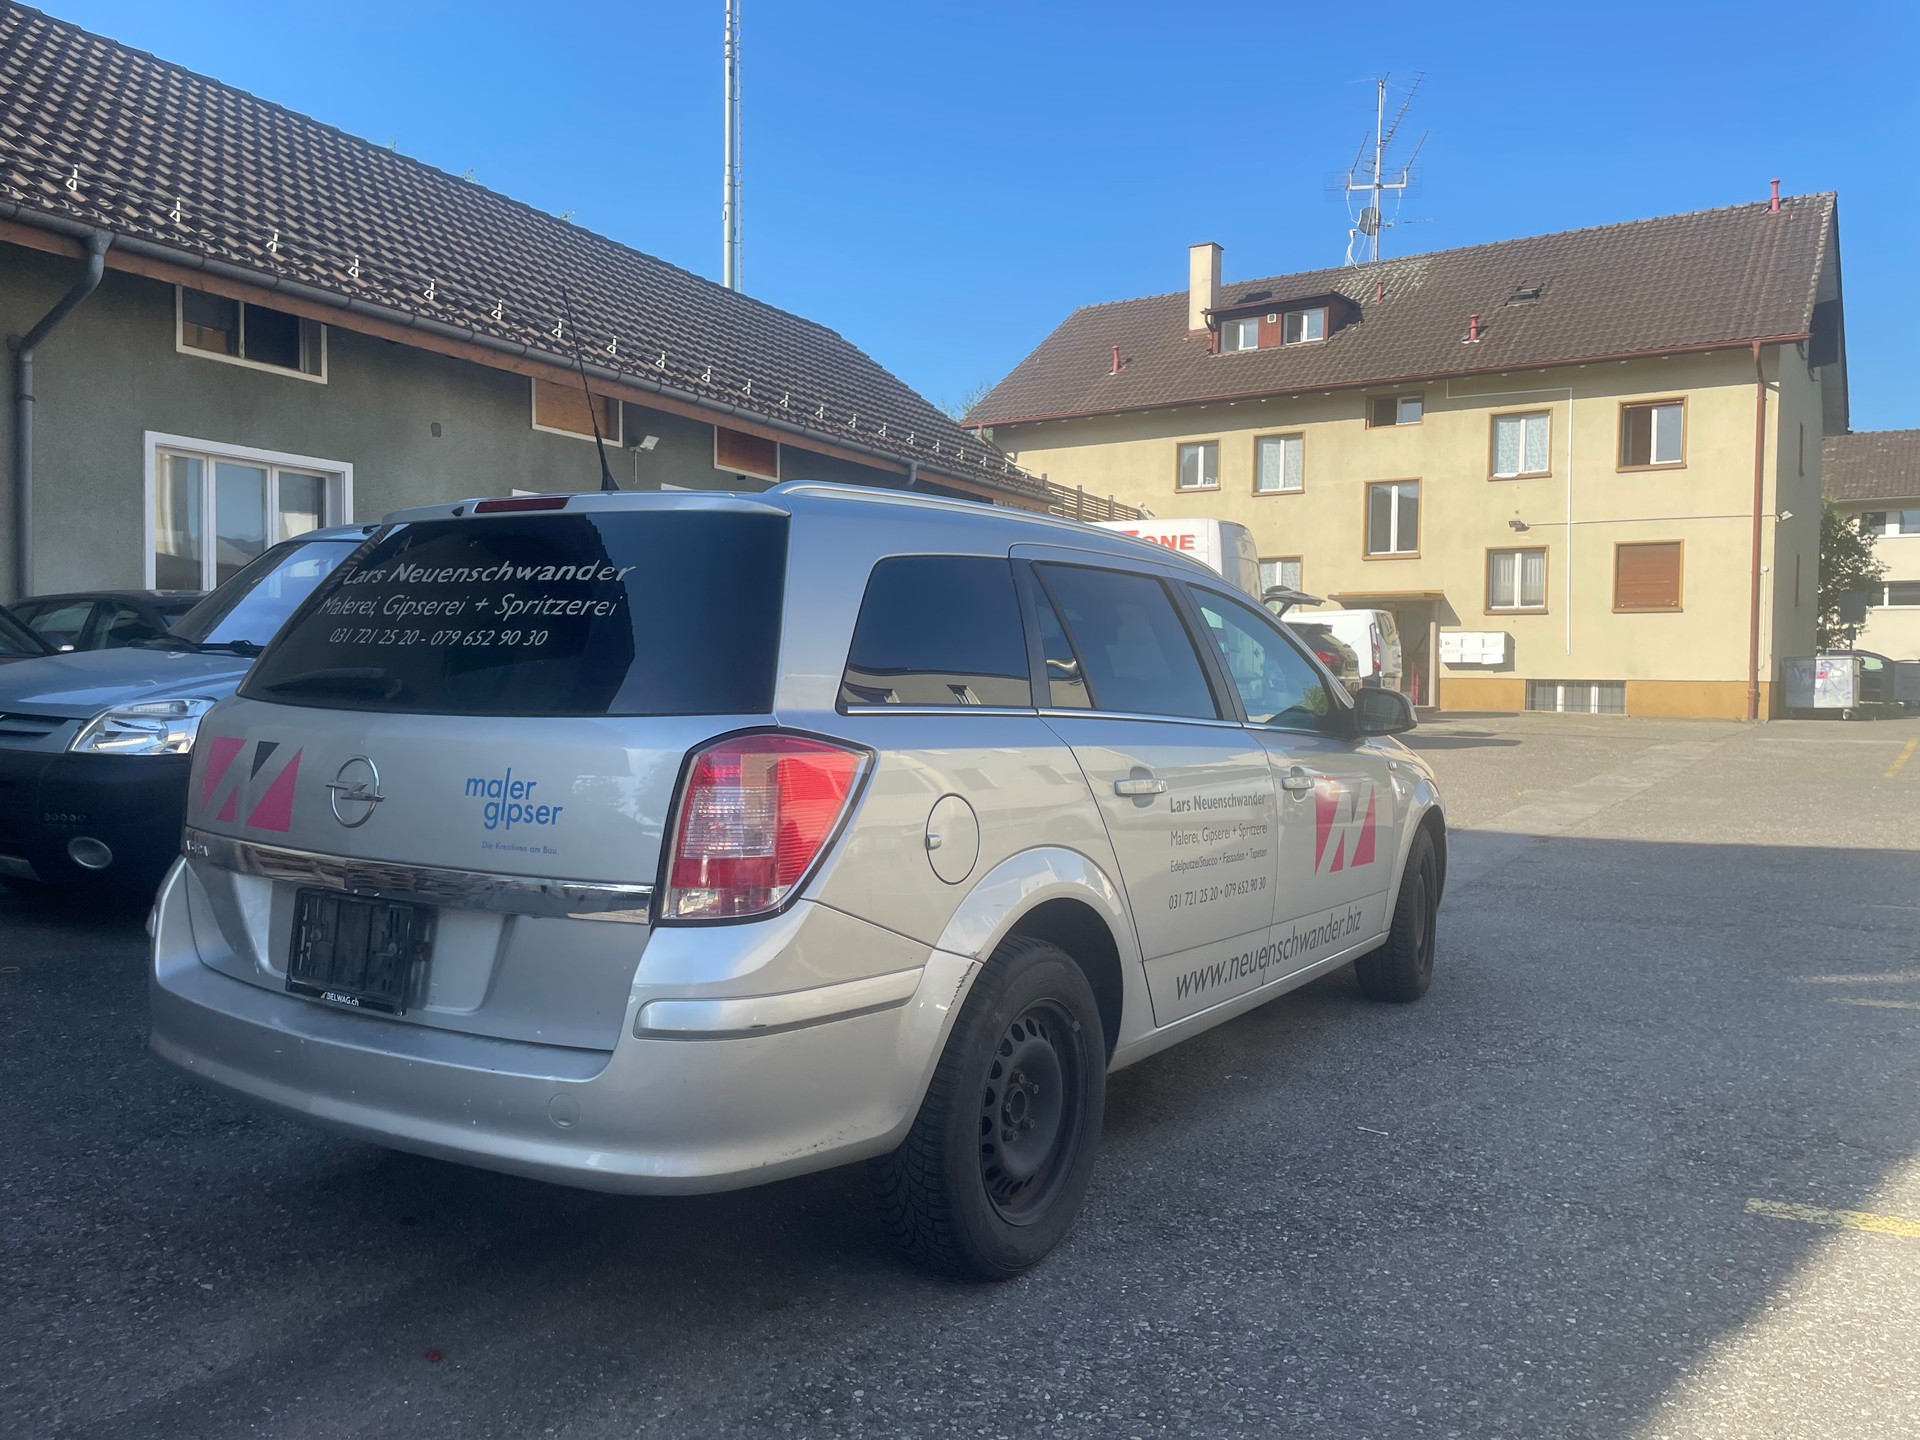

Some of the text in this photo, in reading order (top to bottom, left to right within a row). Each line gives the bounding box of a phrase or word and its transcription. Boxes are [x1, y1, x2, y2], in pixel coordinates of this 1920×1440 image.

[343, 560, 637, 585] Lars Neuenschwander
[318, 596, 381, 618] Malerei,
[383, 594, 470, 622] Gipserei
[495, 593, 623, 622] Spritzerei
[329, 628, 351, 643] 031
[353, 628, 378, 644] 721
[378, 629, 399, 645] 25
[399, 630, 420, 645] 20
[430, 630, 462, 646] 079
[462, 630, 495, 646] 652
[498, 630, 522, 646] 90
[523, 630, 549, 646] 30
[465, 767, 537, 800] maler
[1170, 792, 1266, 813] Lars Neuenschwander
[1202, 825, 1231, 846] Gipserei
[1239, 822, 1268, 840] Spritzerei
[482, 840, 493, 850] Die
[495, 842, 527, 852] Kreativen
[530, 846, 541, 854] am
[1168, 894, 1182, 910] 031
[1184, 891, 1197, 906] 721
[1199, 888, 1208, 904] 25
[1209, 886, 1219, 901] 20
[1224, 882, 1237, 898] 079
[1237, 880, 1249, 895] 652
[1250, 876, 1258, 892] 90
[1258, 876, 1267, 891] 30
[1176, 906, 1361, 1000] www.neuenschwander.biz
